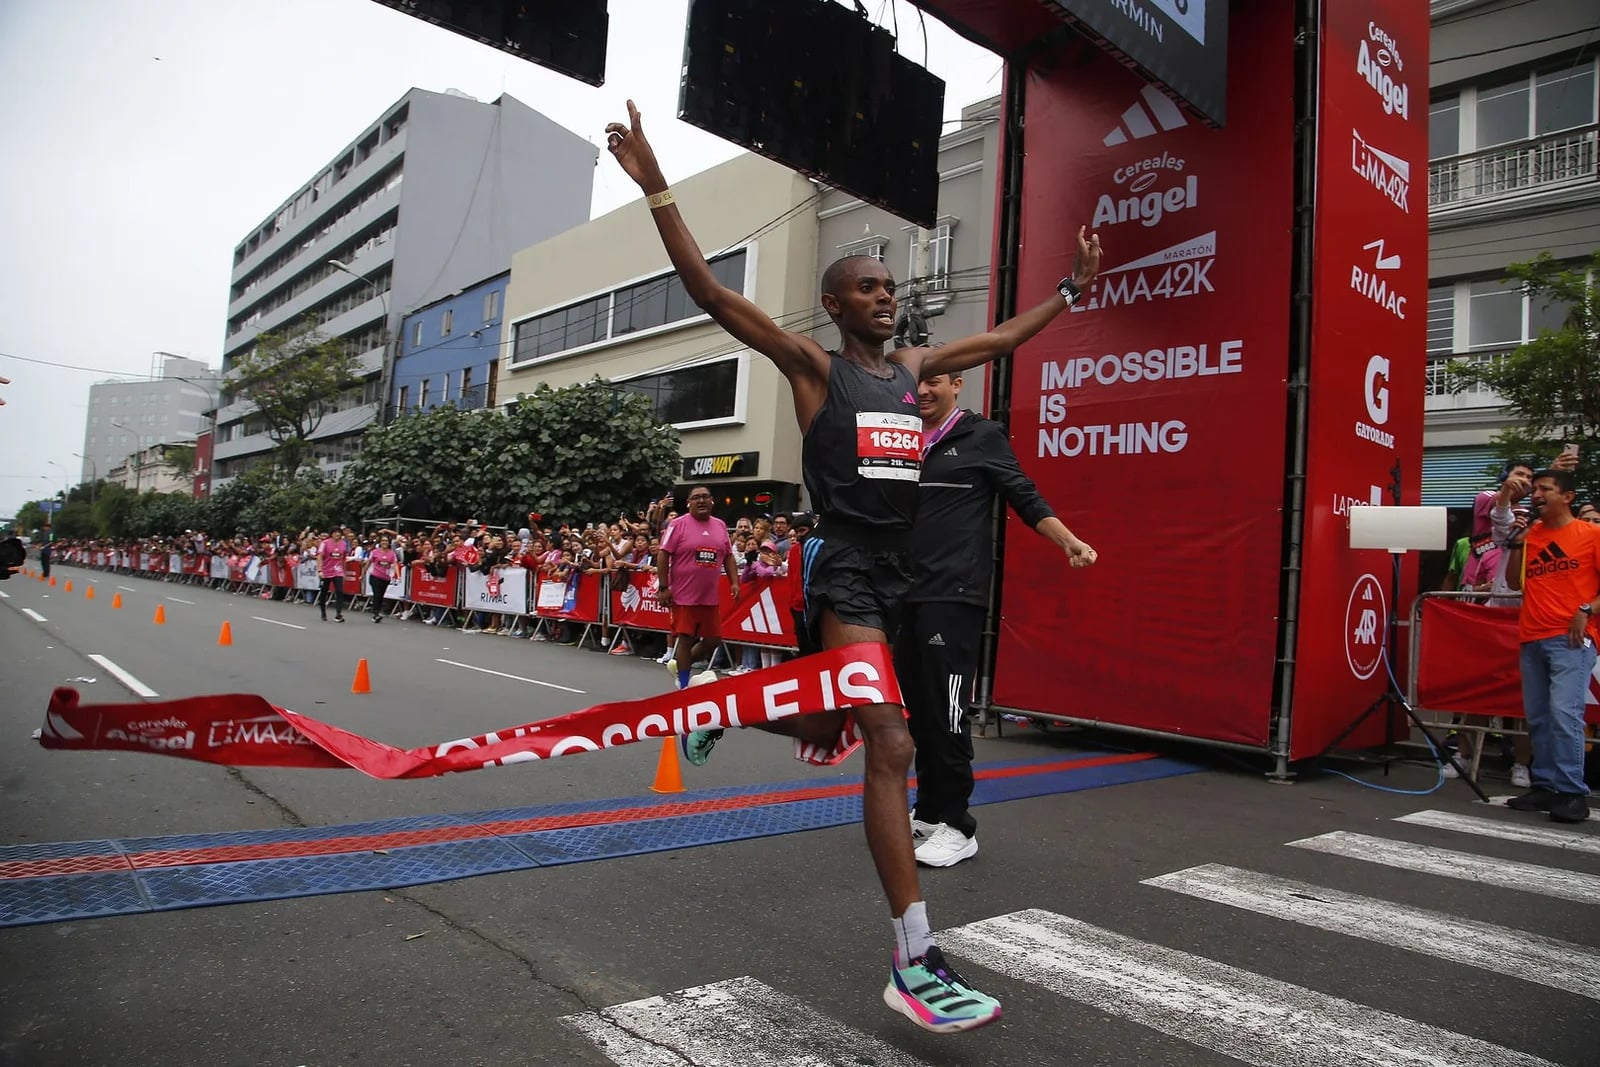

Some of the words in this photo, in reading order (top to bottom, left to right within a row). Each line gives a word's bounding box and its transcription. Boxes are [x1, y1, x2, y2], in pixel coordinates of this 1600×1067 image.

[1111, 0, 1163, 43] RMIN
[1368, 21, 1404, 71] Cereales
[1356, 39, 1408, 120] Angel
[1113, 151, 1185, 184] Cereales
[1091, 175, 1198, 229] Angel
[1350, 264, 1407, 320] RIMAC
[1040, 339, 1243, 391] IMPOSSIBLE
[1364, 354, 1390, 425] G
[1039, 394, 1067, 424] IS
[870, 431, 920, 451] 16264
[1038, 420, 1188, 458] NOTHING
[1355, 421, 1395, 450] GATORADE
[690, 455, 743, 475] SUBWAY
[1525, 559, 1579, 579] adidas
[480, 592, 508, 605] RIMAC
[820, 661, 884, 711] IS
[207, 720, 313, 748] LIMA42
